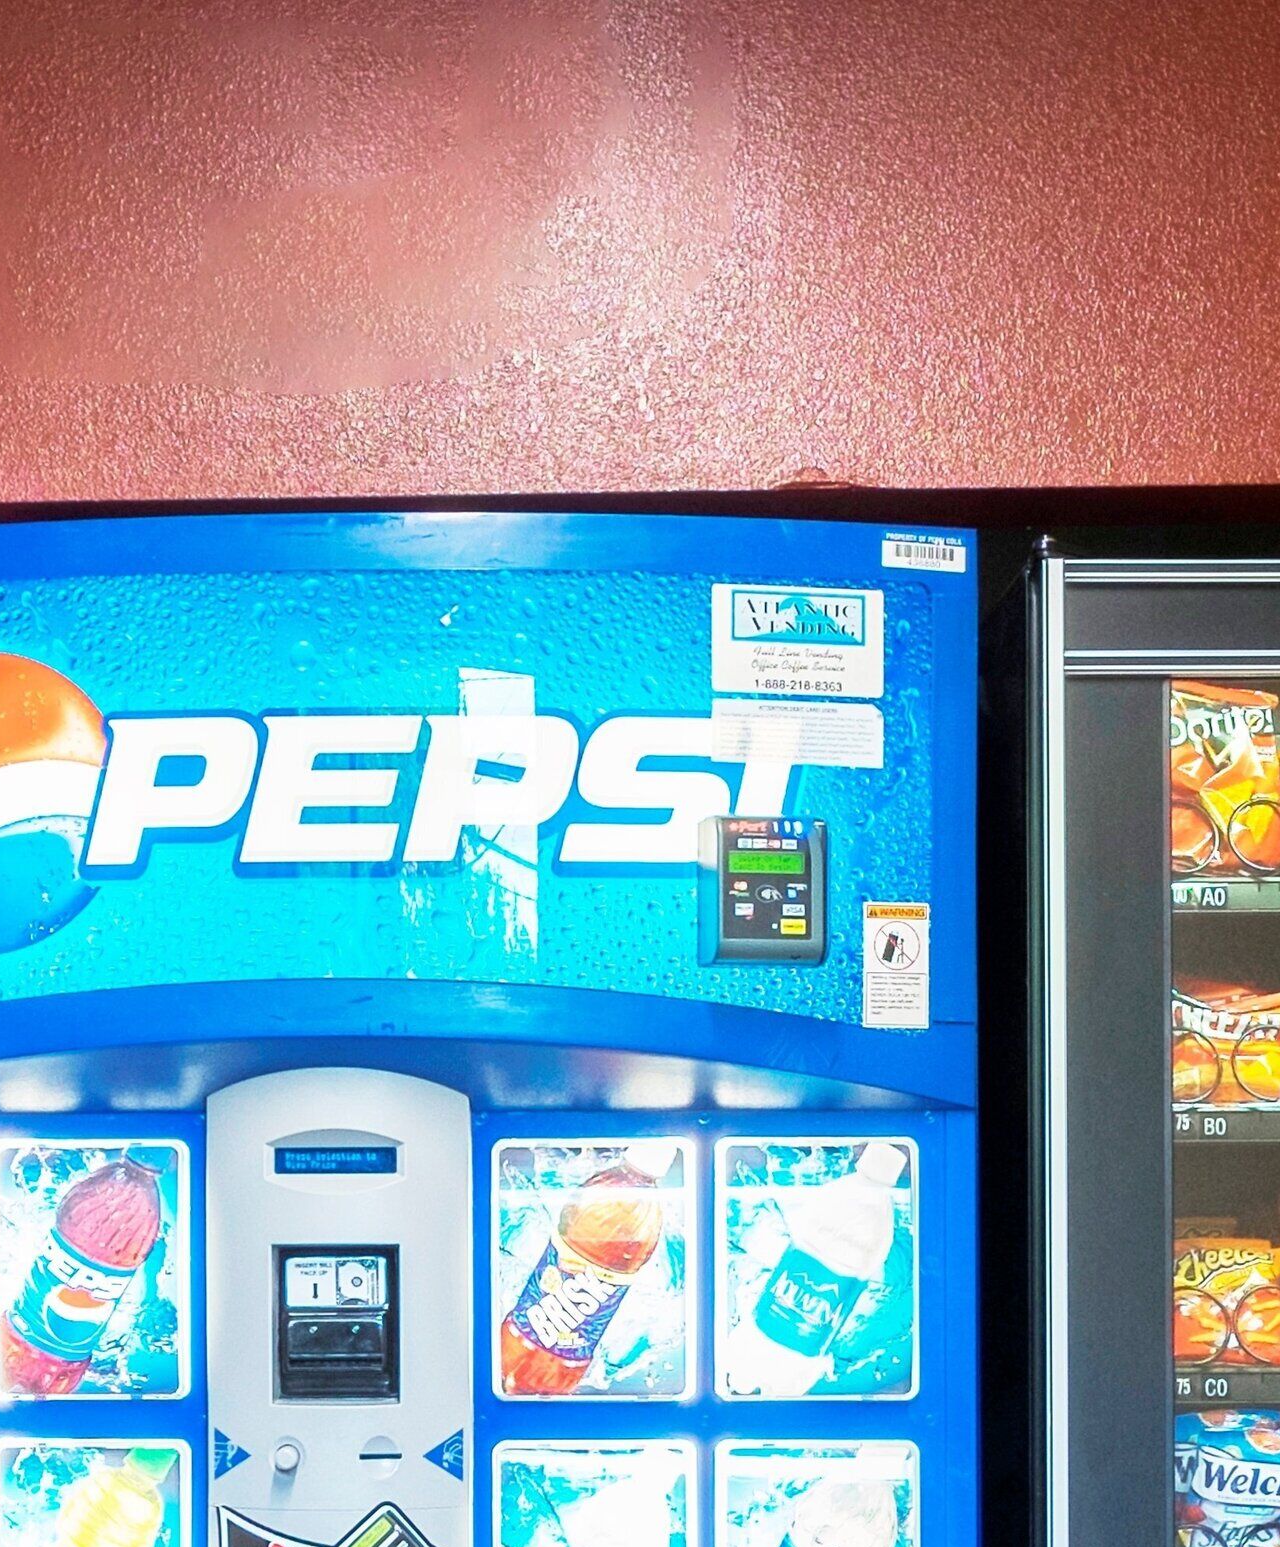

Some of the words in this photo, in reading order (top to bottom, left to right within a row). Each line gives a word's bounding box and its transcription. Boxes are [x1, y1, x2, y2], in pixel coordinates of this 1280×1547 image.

[742, 599, 856, 618] ATLANTIC
[752, 617, 855, 636] VENDING
[755, 679, 842, 692] 1-888-218-8363
[1201, 887, 1226, 907] A0
[879, 908, 926, 918] WARNING
[1204, 1118, 1227, 1135] B0
[527, 1264, 618, 1349] BRISK
[1205, 1379, 1228, 1397] C0
